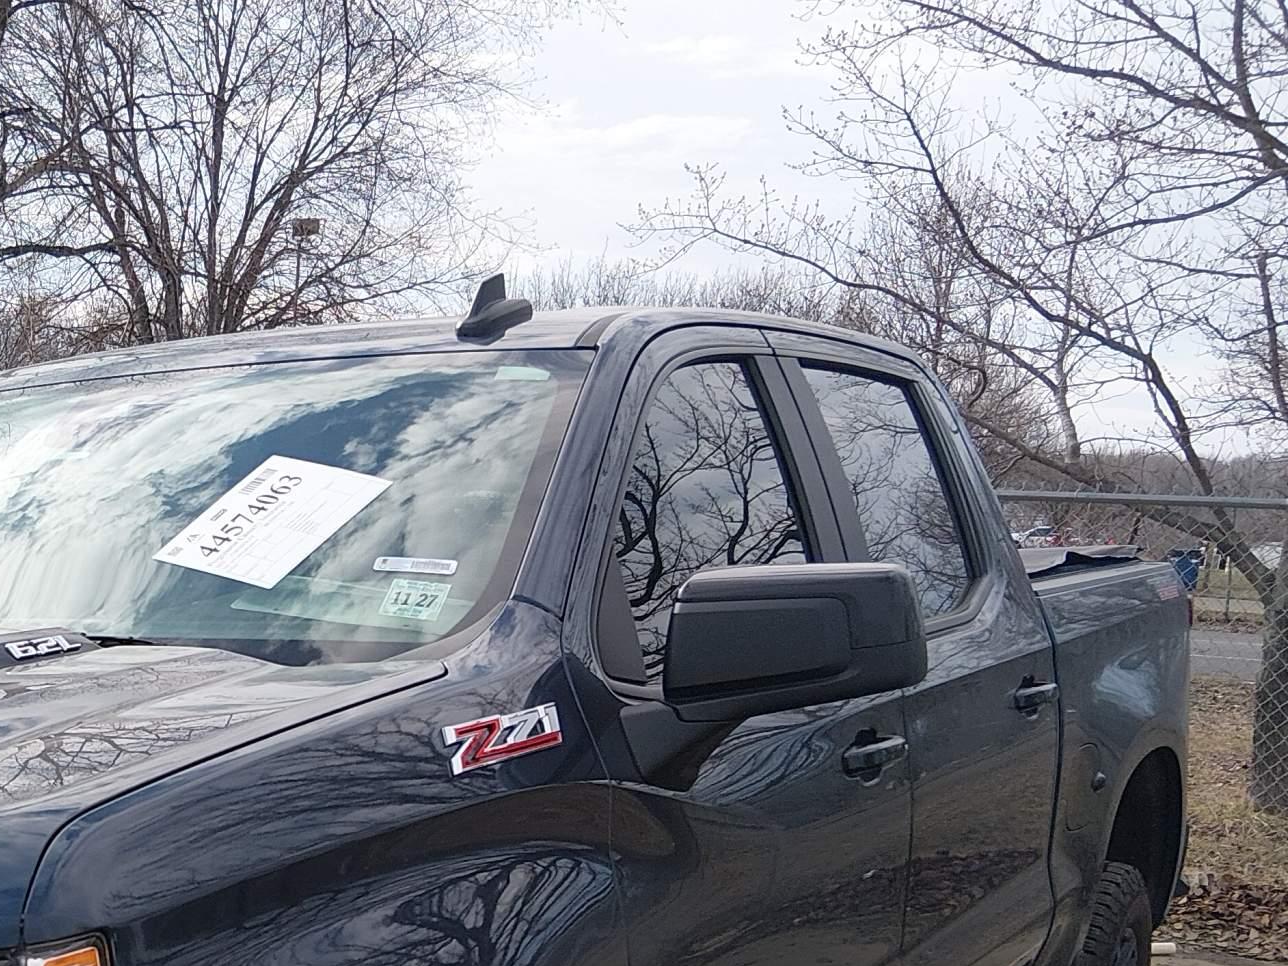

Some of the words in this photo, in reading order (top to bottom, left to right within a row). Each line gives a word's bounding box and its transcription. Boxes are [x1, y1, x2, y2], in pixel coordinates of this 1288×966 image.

[200, 475, 303, 558] 44574063
[391, 591, 412, 606] 11
[415, 592, 439, 609] 27
[442, 701, 563, 776] Z71
